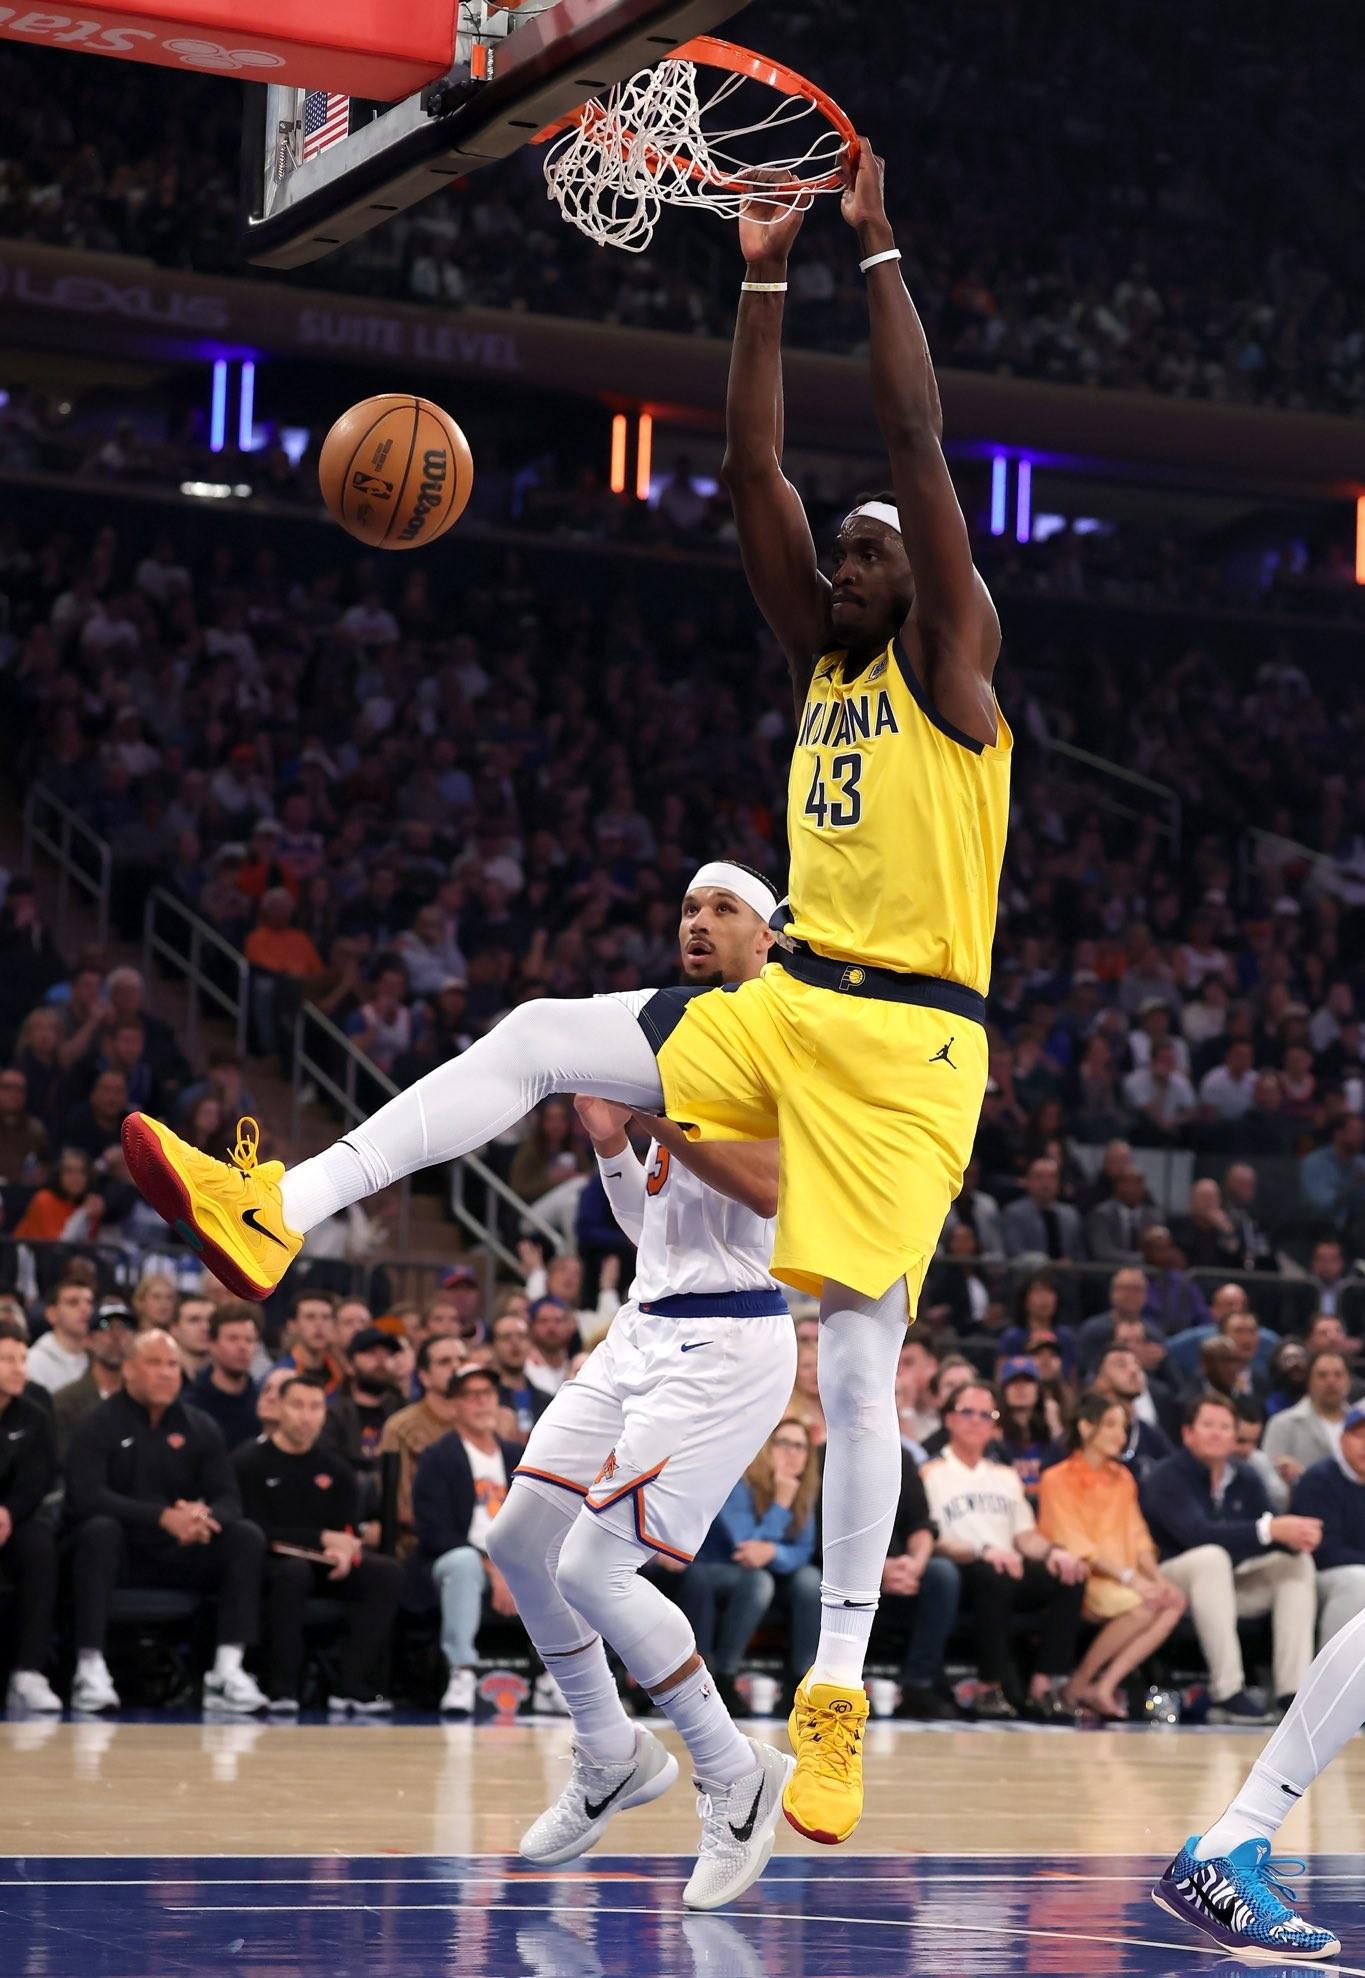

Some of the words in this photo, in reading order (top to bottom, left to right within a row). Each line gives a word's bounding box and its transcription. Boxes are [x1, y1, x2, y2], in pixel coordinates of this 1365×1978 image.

[15, 270, 230, 329] LEXUS
[412, 324, 520, 370] LEVEL
[398, 449, 448, 541] Wilson
[799, 690, 899, 748] NDIANA
[804, 752, 863, 828] 43
